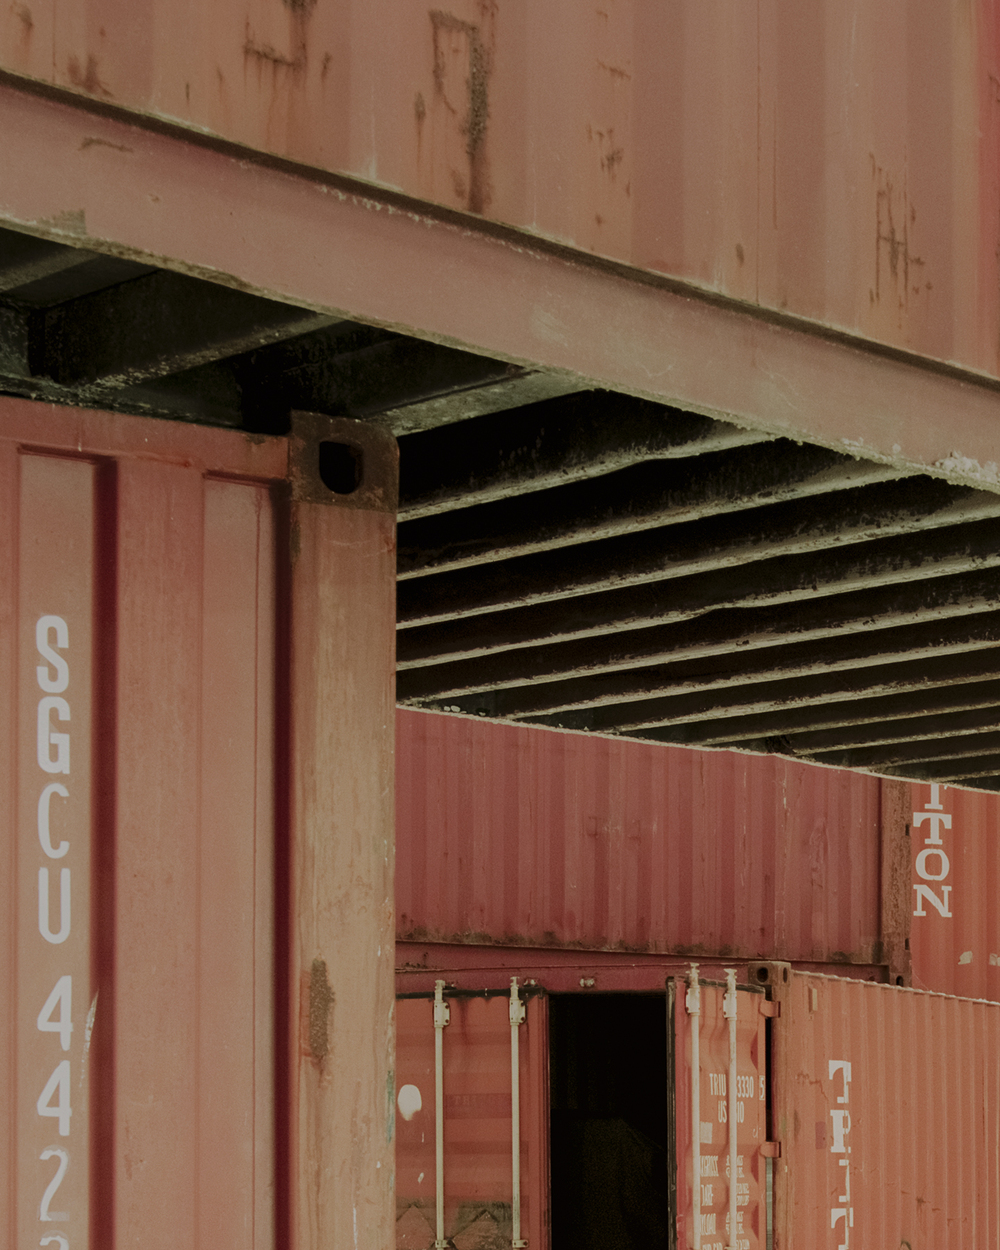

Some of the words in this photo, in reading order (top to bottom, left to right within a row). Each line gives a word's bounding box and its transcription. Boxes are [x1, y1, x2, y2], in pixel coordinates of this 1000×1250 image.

[36, 614, 71, 945] SGCU
[709, 1073, 727, 1096] TRIU
[718, 1100, 727, 1123] US
